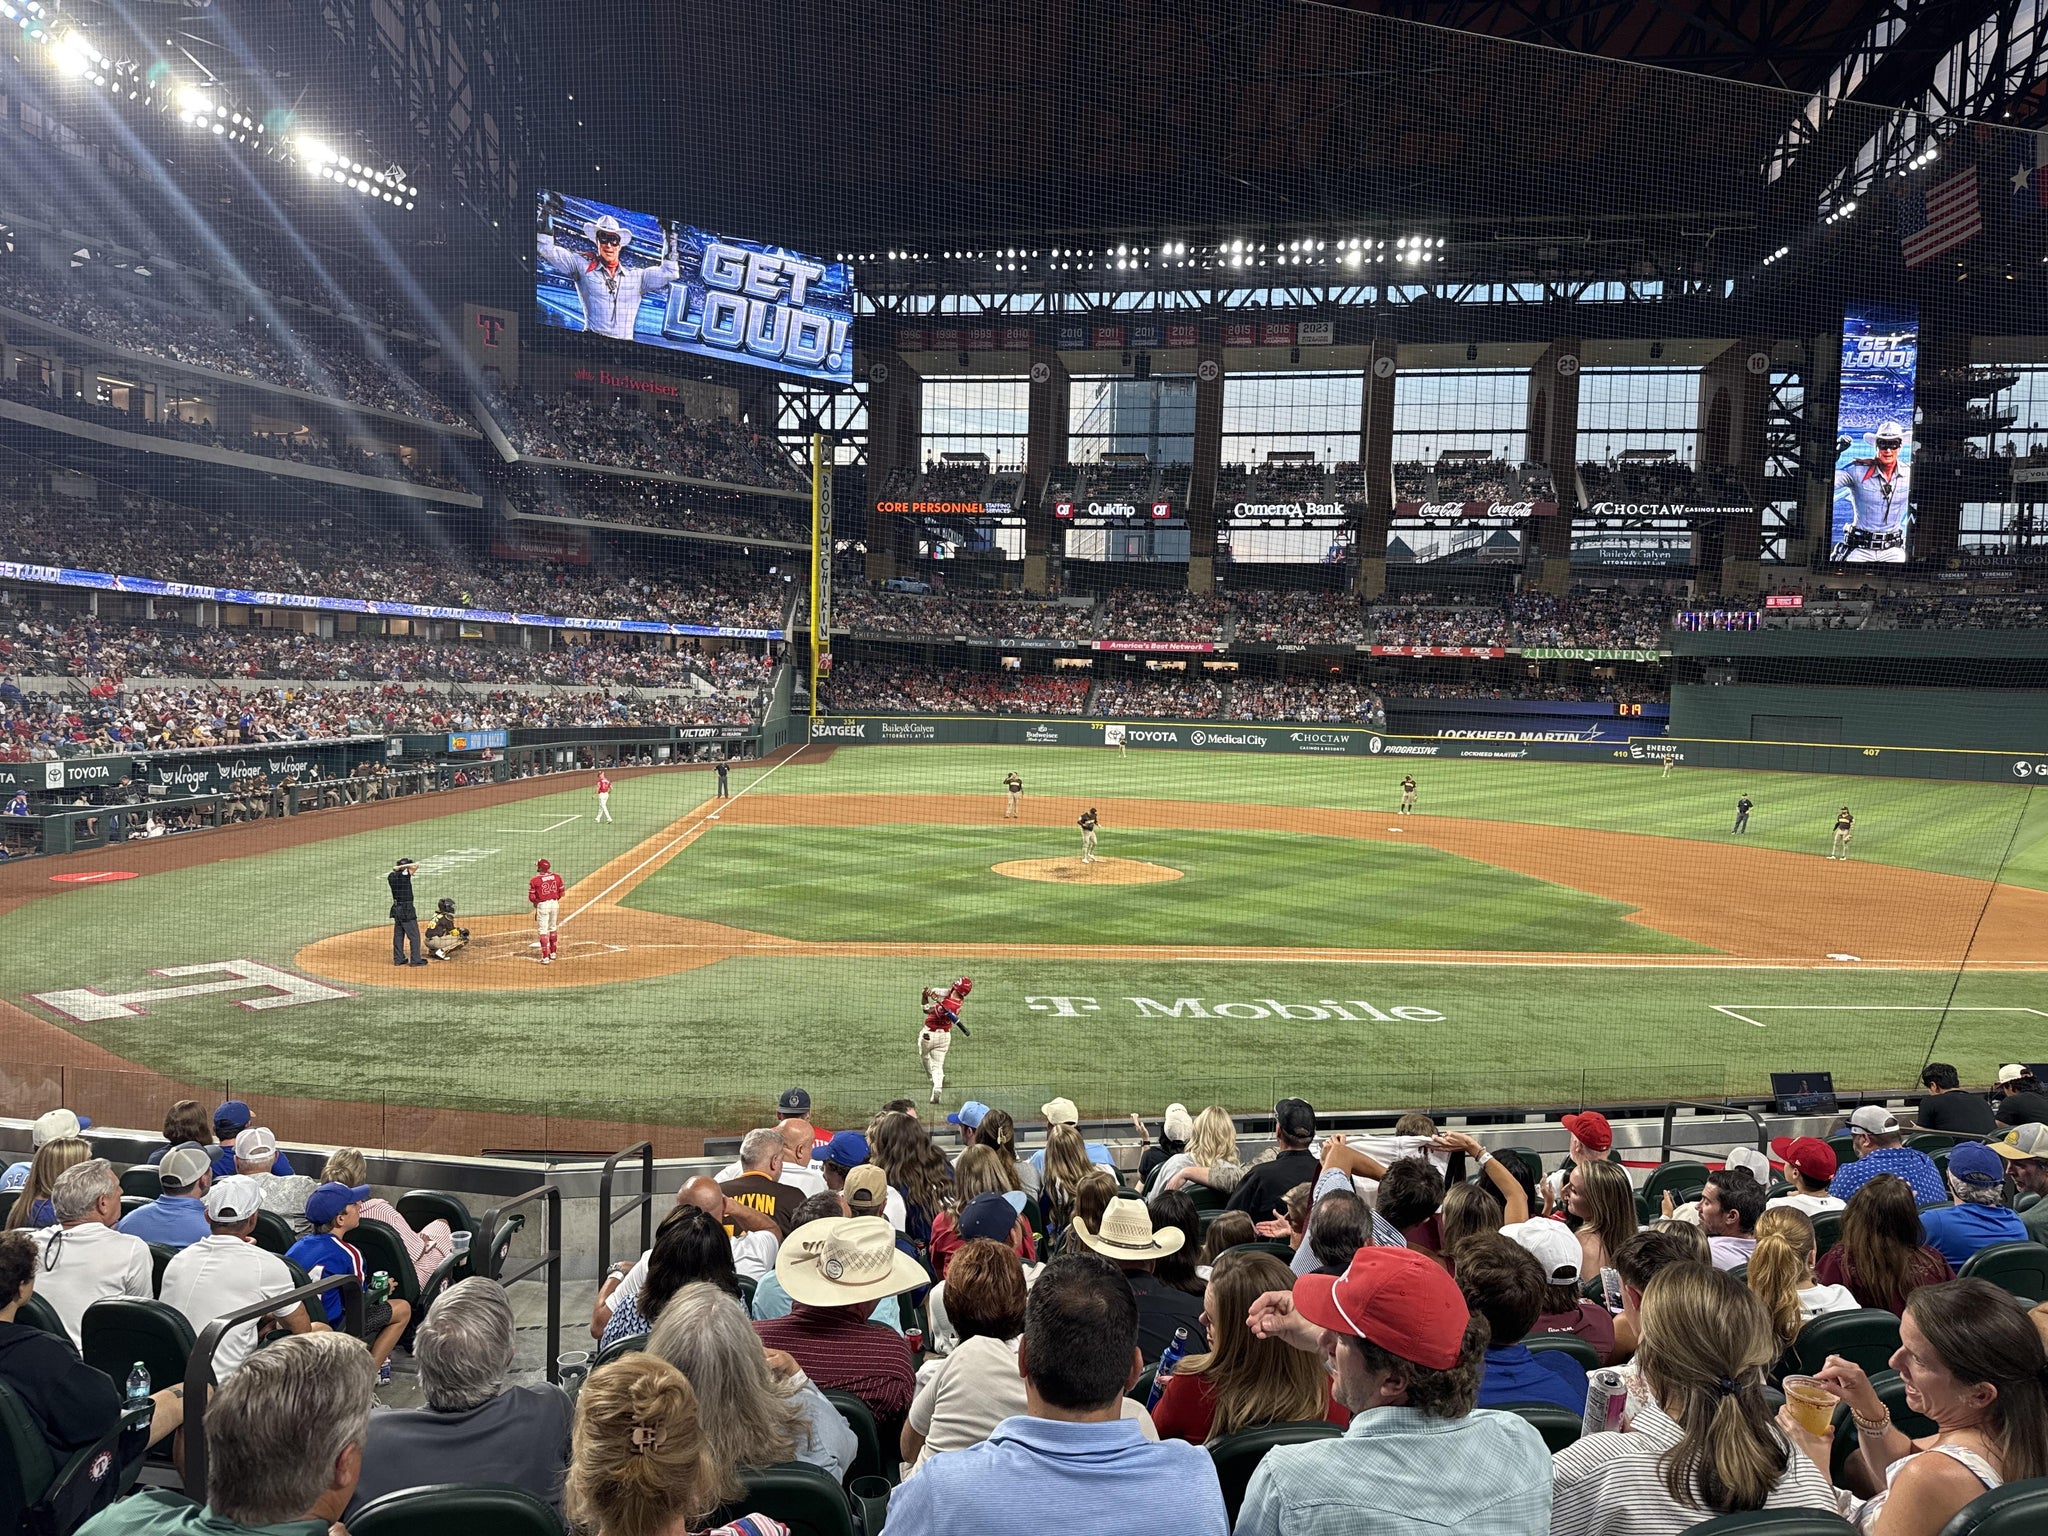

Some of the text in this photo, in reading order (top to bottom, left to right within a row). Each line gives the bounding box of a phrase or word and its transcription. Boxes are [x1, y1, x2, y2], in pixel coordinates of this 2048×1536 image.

[701, 243, 824, 307] GET
[661, 281, 850, 373] LOUD!
[1006, 328, 1029, 338] 2010
[1061, 328, 1082, 337] 2010
[1099, 327, 1119, 337] 2011
[1135, 327, 1154, 337] 2011
[1172, 326, 1194, 336] 2012
[1228, 324, 1251, 334] 2015
[1266, 324, 1290, 334] 2016
[1303, 323, 1329, 333] 2023
[1857, 336, 1904, 350] GET
[1559, 359, 1577, 371] 29
[1752, 358, 1765, 370] 10
[1843, 351, 1914, 368] LOUD!
[1033, 367, 1048, 379] 34
[1200, 364, 1217, 377] 26
[1381, 361, 1389, 373] 7
[599, 370, 678, 397] Budweiser
[821, 474, 830, 529] ROOT
[877, 502, 985, 514] CORE PERSONNEL
[1056, 504, 1071, 515] QT
[1088, 502, 1136, 518] QuikTrip
[1153, 505, 1168, 516] QT
[1305, 502, 1345, 516] Bank
[1418, 502, 1465, 518] Coca-Cola
[1487, 501, 1535, 517] Coca-Cola
[1601, 502, 1685, 516] CHOCTAW
[1963, 557, 2019, 566] PRIORITY
[166, 582, 189, 596] GET
[256, 592, 320, 608] GET LOUD!
[820, 558, 829, 638] CHIKIN
[413, 605, 437, 618] GET
[565, 617, 589, 630] GET
[718, 627, 741, 638] GET
[1151, 642, 1168, 650] Best
[1535, 648, 1657, 661] LUXOR STAFFING
[1619, 703, 1642, 716] 0:19
[679, 727, 717, 738] VICTORY
[811, 724, 865, 738] SEATGEEK
[882, 723, 935, 734] Bailey&Galyen
[1026, 731, 1059, 739] Budweiser
[1128, 730, 1178, 742] TOYOTA
[1207, 734, 1268, 748] Medical City
[1296, 732, 1350, 743] CHOCTAW
[1437, 730, 1580, 742] LOCKHEED MARTIN
[1384, 745, 1440, 755] PROGRESSIVE
[1460, 750, 1493, 758] LOCKHEED
[1646, 744, 1678, 752] ENERGY
[1862, 748, 1880, 757] 407
[67, 765, 110, 780] TOYOTA
[280, 755, 308, 781] Kroger
[174, 764, 209, 793] Kroger
[541, 880, 558, 896] 24
[1122, 996, 1448, 1023] Mobile
